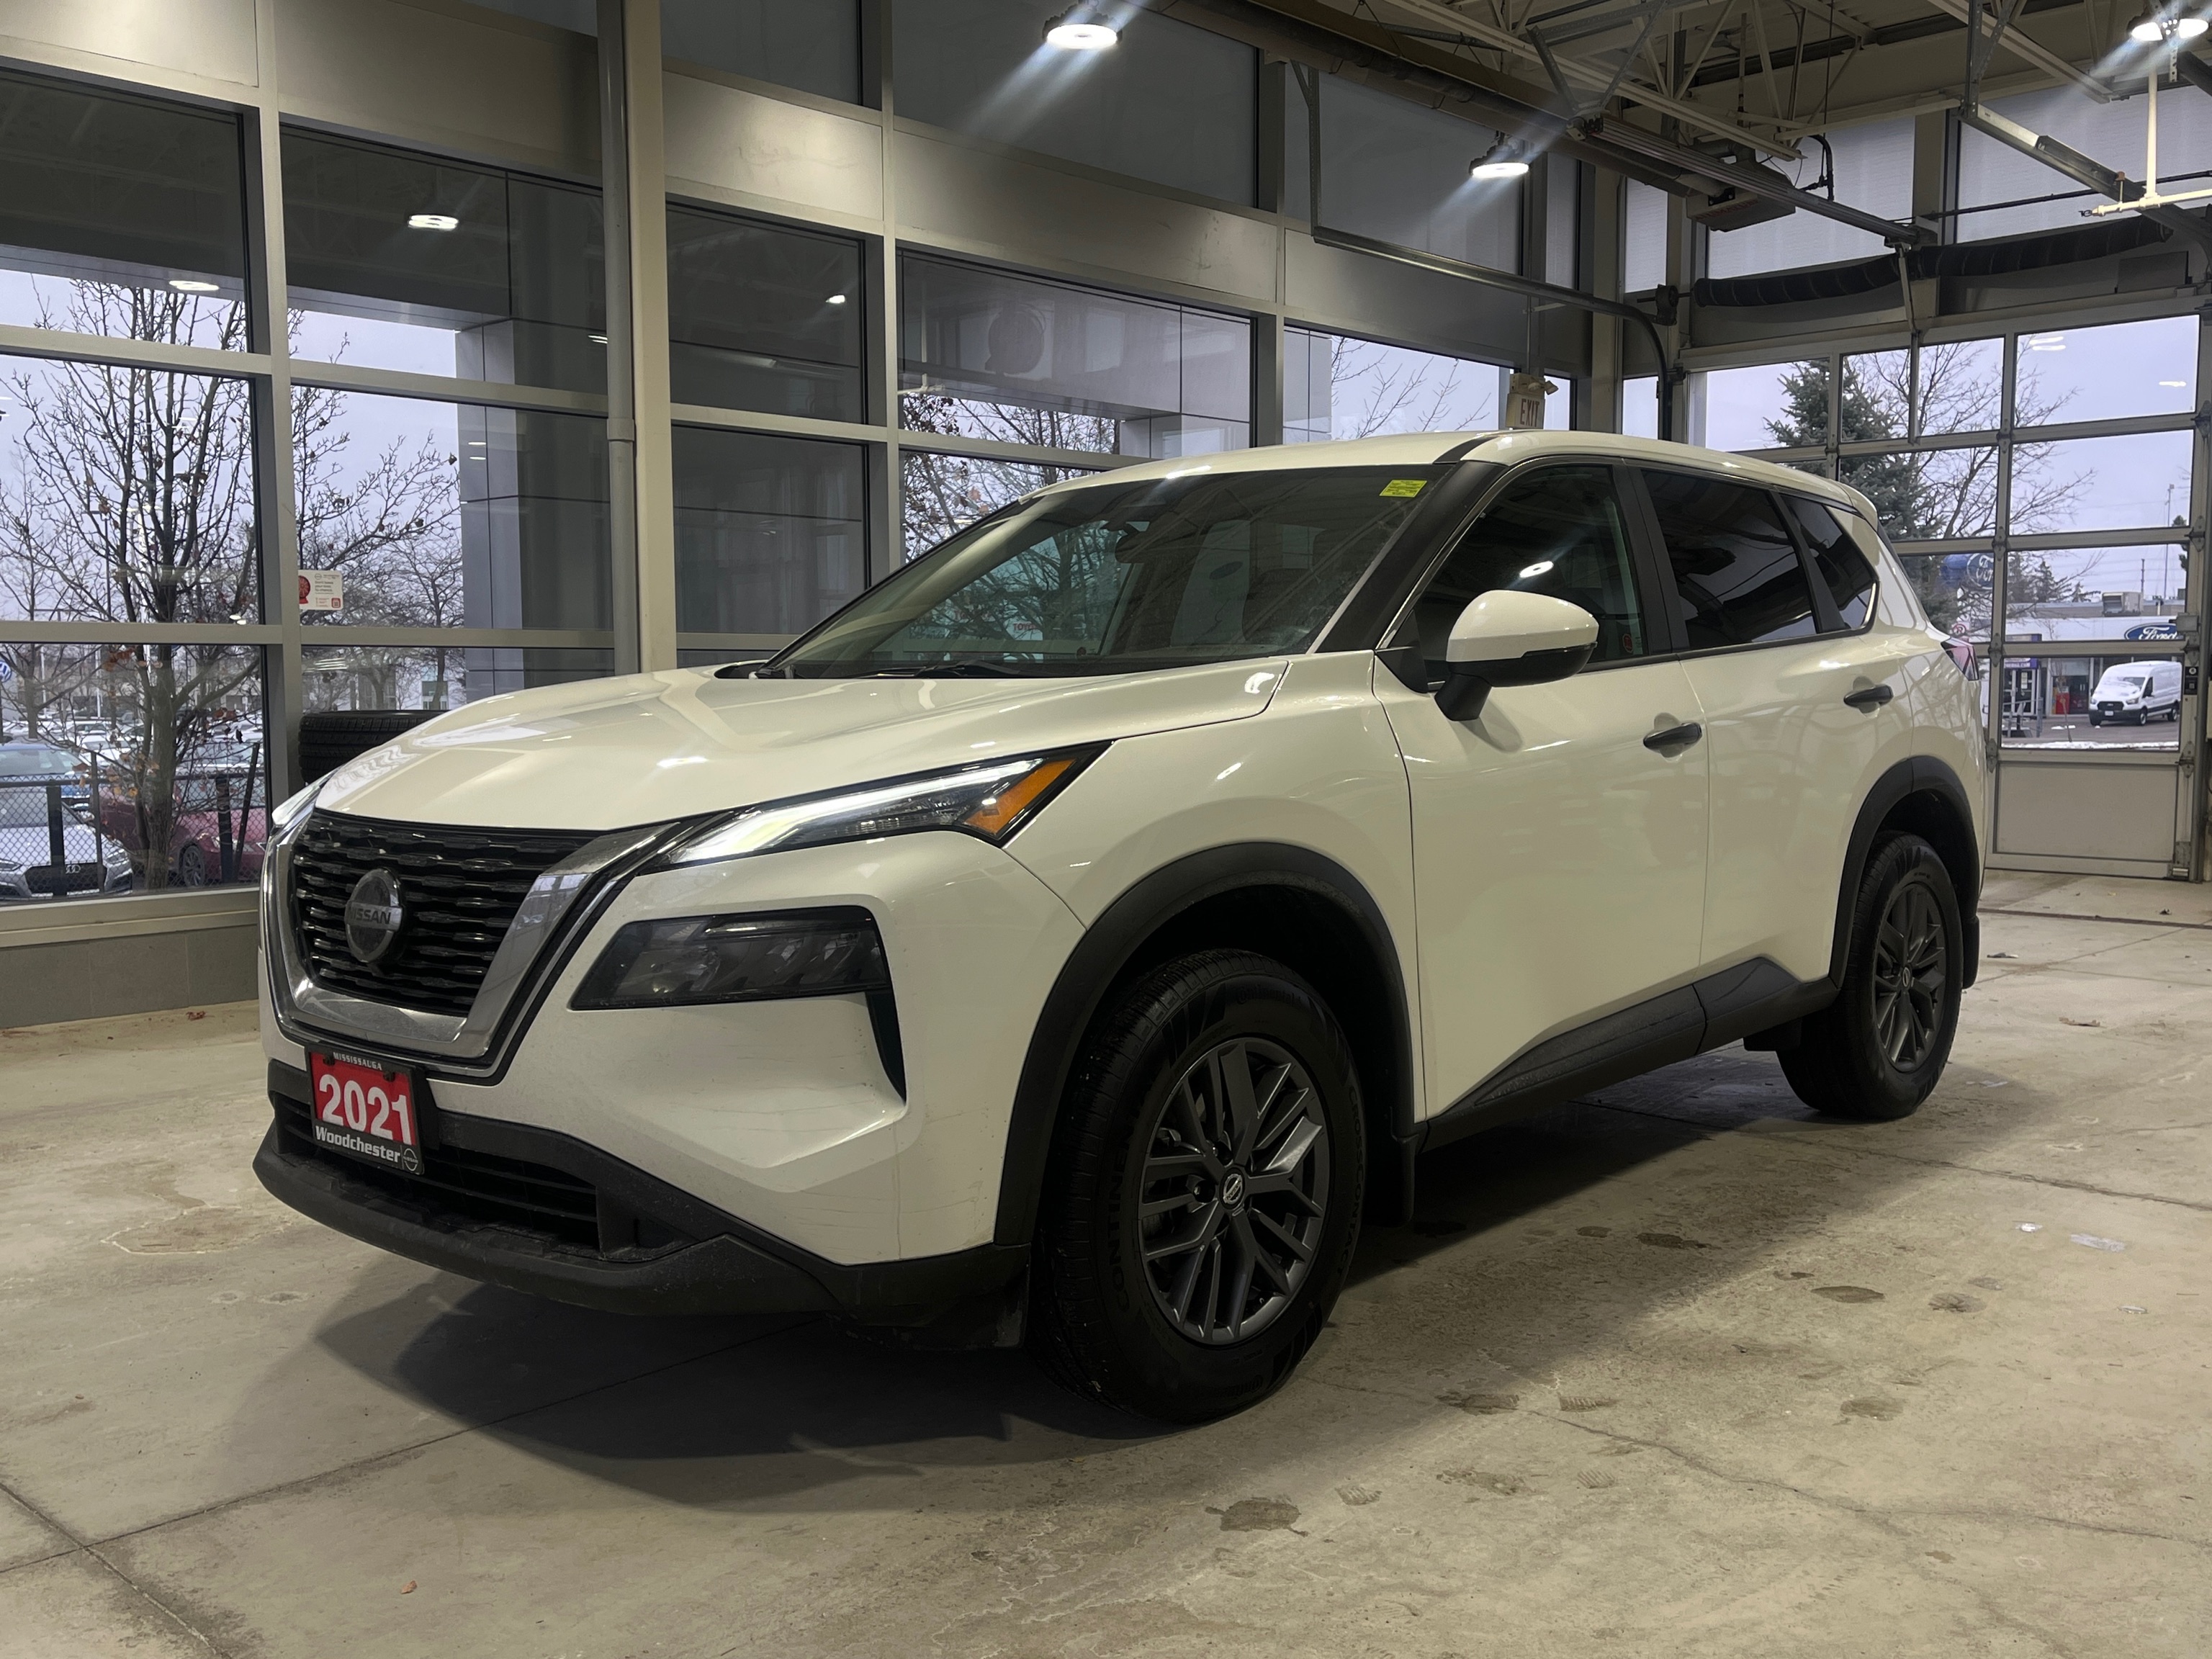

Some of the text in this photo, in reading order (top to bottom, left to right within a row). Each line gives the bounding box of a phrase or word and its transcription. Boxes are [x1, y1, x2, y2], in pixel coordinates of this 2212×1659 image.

[1520, 398, 1540, 428] EXIT
[1976, 554, 1994, 582] For
[351, 905, 392, 925] NISSAN
[333, 1051, 382, 1071] MISSISSAUGA
[319, 1074, 413, 1146] 2021
[315, 1125, 401, 1163] Woodchester
